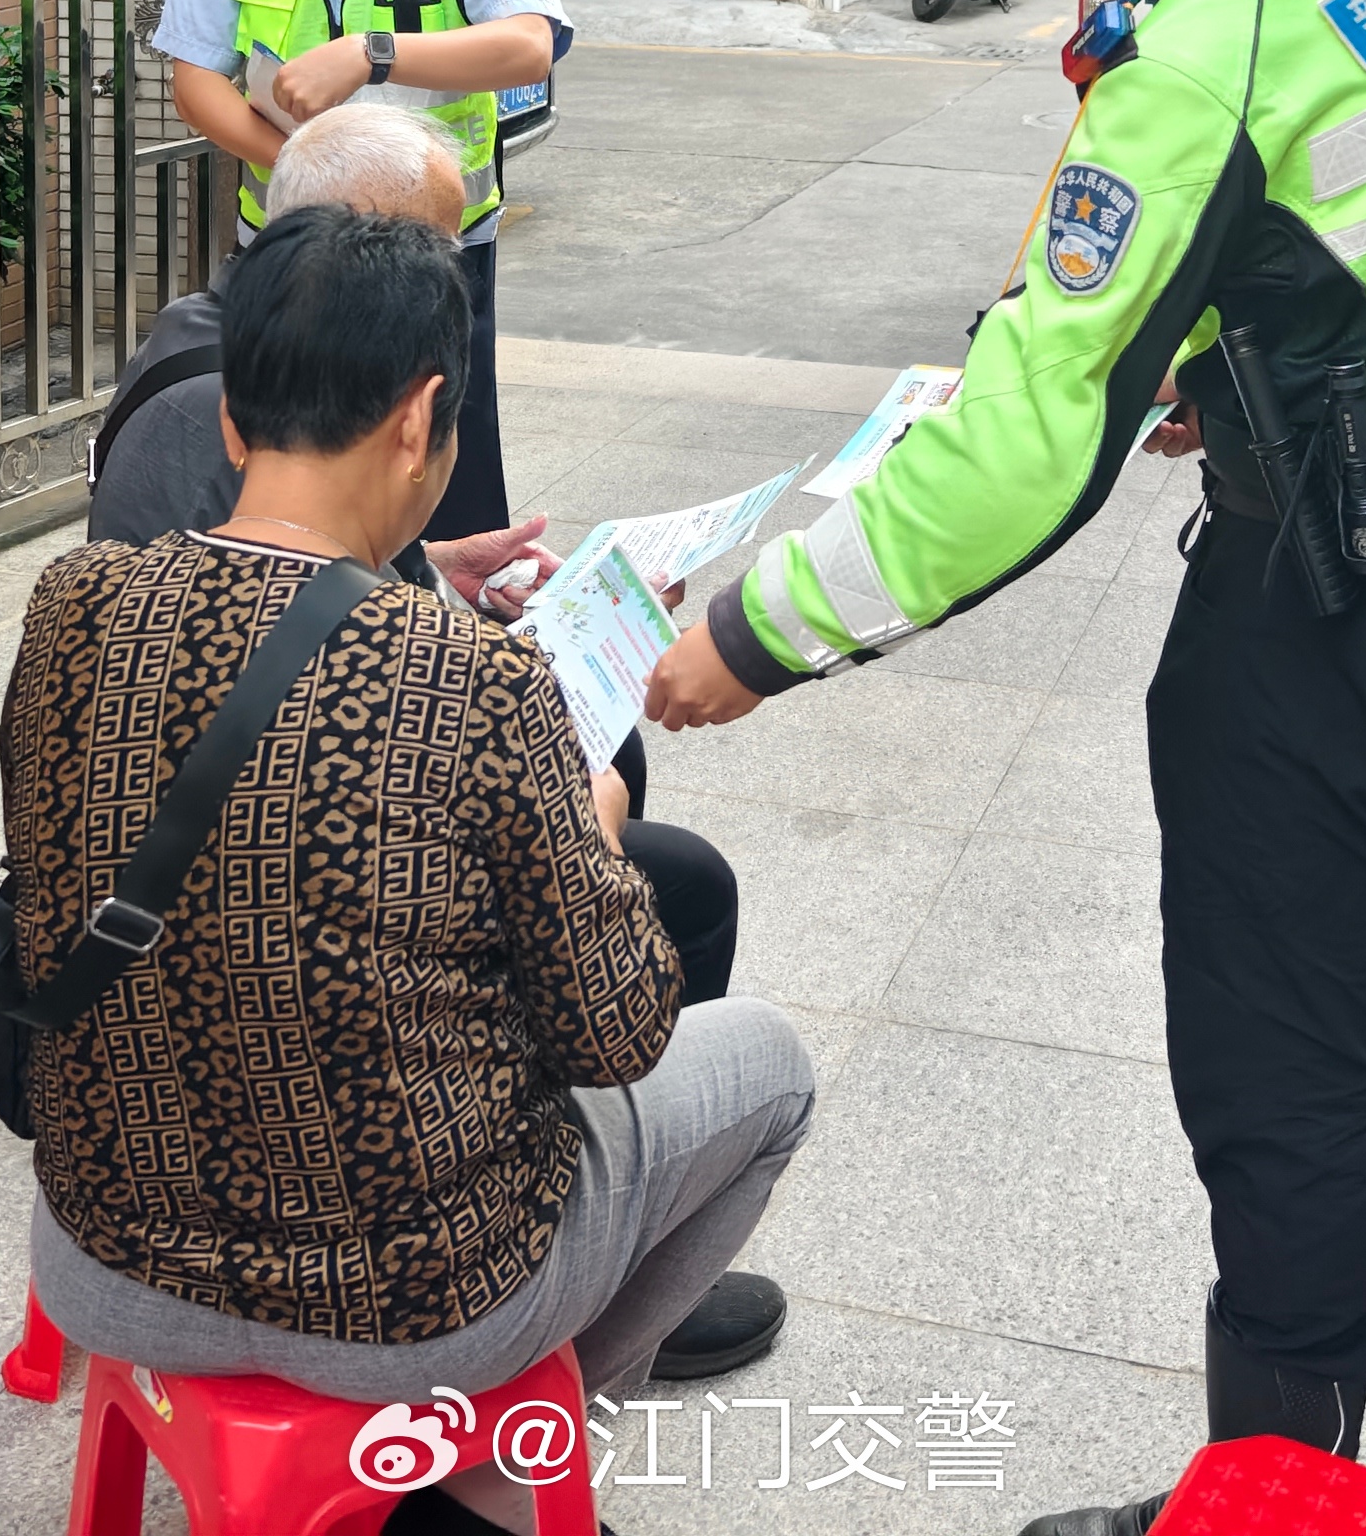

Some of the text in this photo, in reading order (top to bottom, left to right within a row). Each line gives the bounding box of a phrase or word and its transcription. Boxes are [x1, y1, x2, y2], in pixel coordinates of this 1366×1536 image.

[1057, 169, 1135, 216] 中华人民共和国
